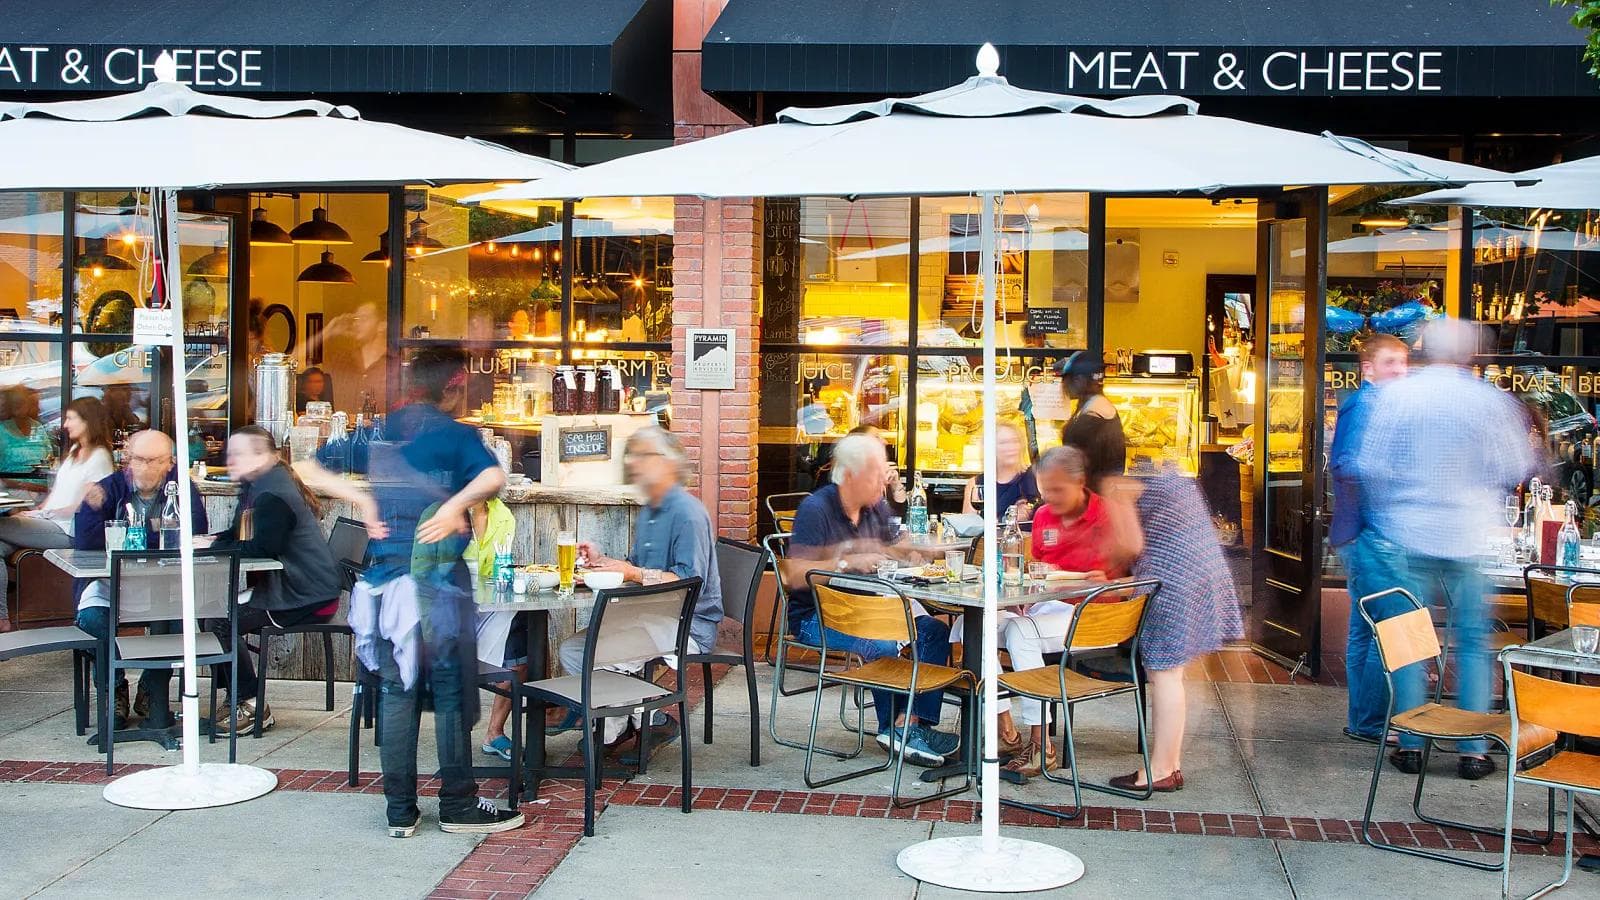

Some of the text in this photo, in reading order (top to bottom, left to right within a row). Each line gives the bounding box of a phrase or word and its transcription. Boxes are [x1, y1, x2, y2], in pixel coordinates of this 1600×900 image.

[60, 48, 91, 84] &
[104, 48, 262, 86] CHEESE
[1068, 51, 1442, 92] MEAT & CHEESE
[113, 351, 153, 368] CHE
[593, 359, 672, 377] FARM E
[795, 361, 853, 385] JUICE
[948, 364, 1056, 384] PRODUCE
[1495, 374, 1571, 393] CRAFT
[565, 443, 606, 455] INSIDE
